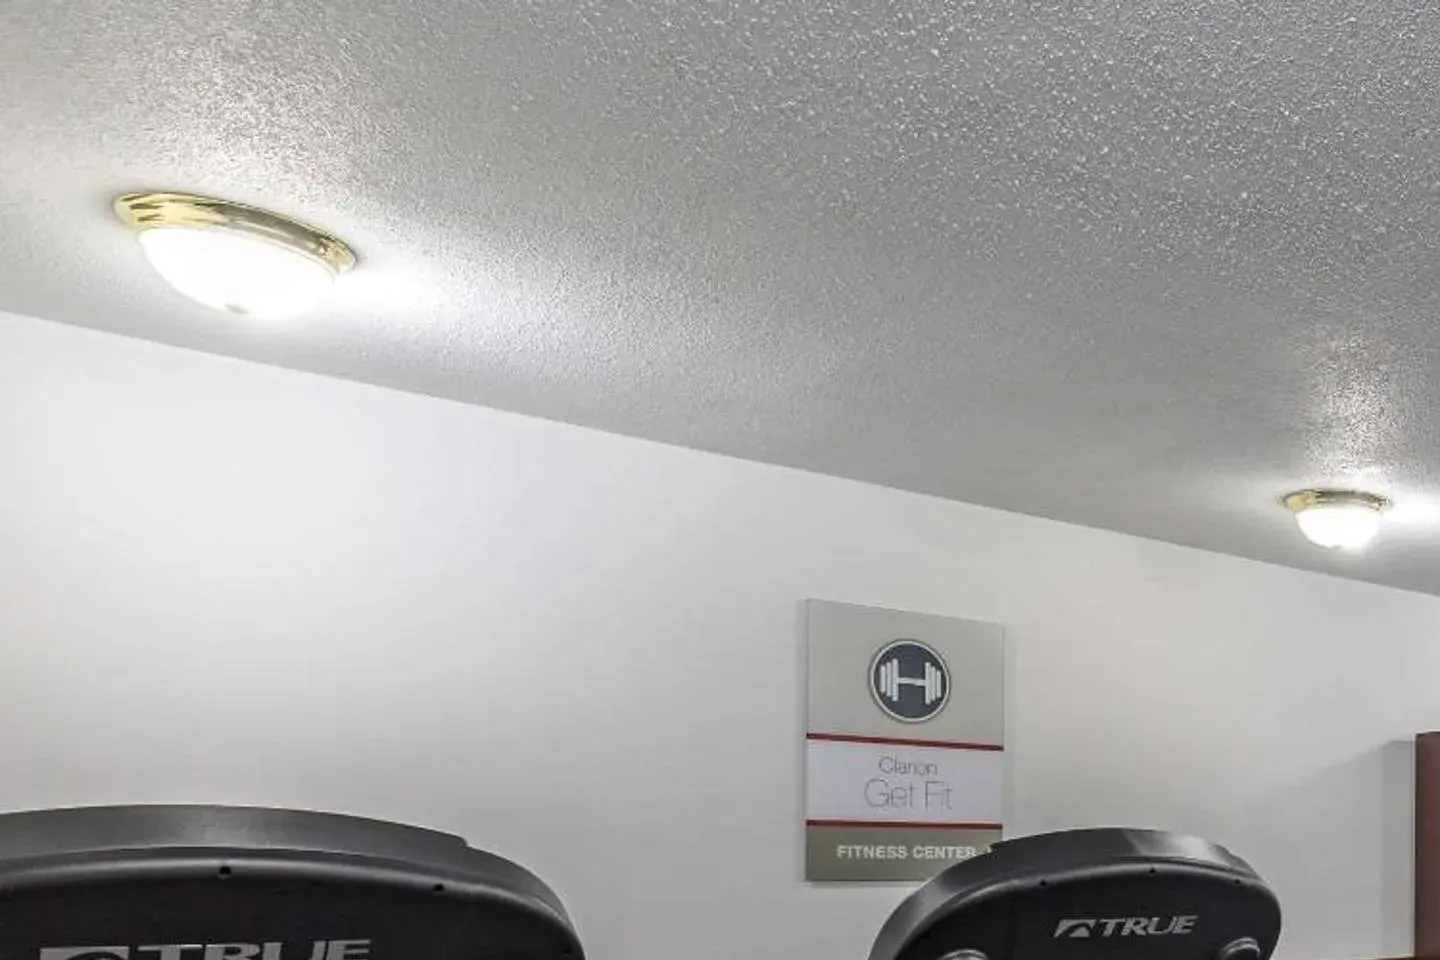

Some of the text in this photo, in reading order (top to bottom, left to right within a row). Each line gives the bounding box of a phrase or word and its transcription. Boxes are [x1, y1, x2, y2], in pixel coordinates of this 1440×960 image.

[878, 756, 938, 775] Clarion
[864, 778, 953, 810] Get Fit
[837, 845, 977, 859] FITNESS CENTER
[1100, 914, 1199, 937] TRUE
